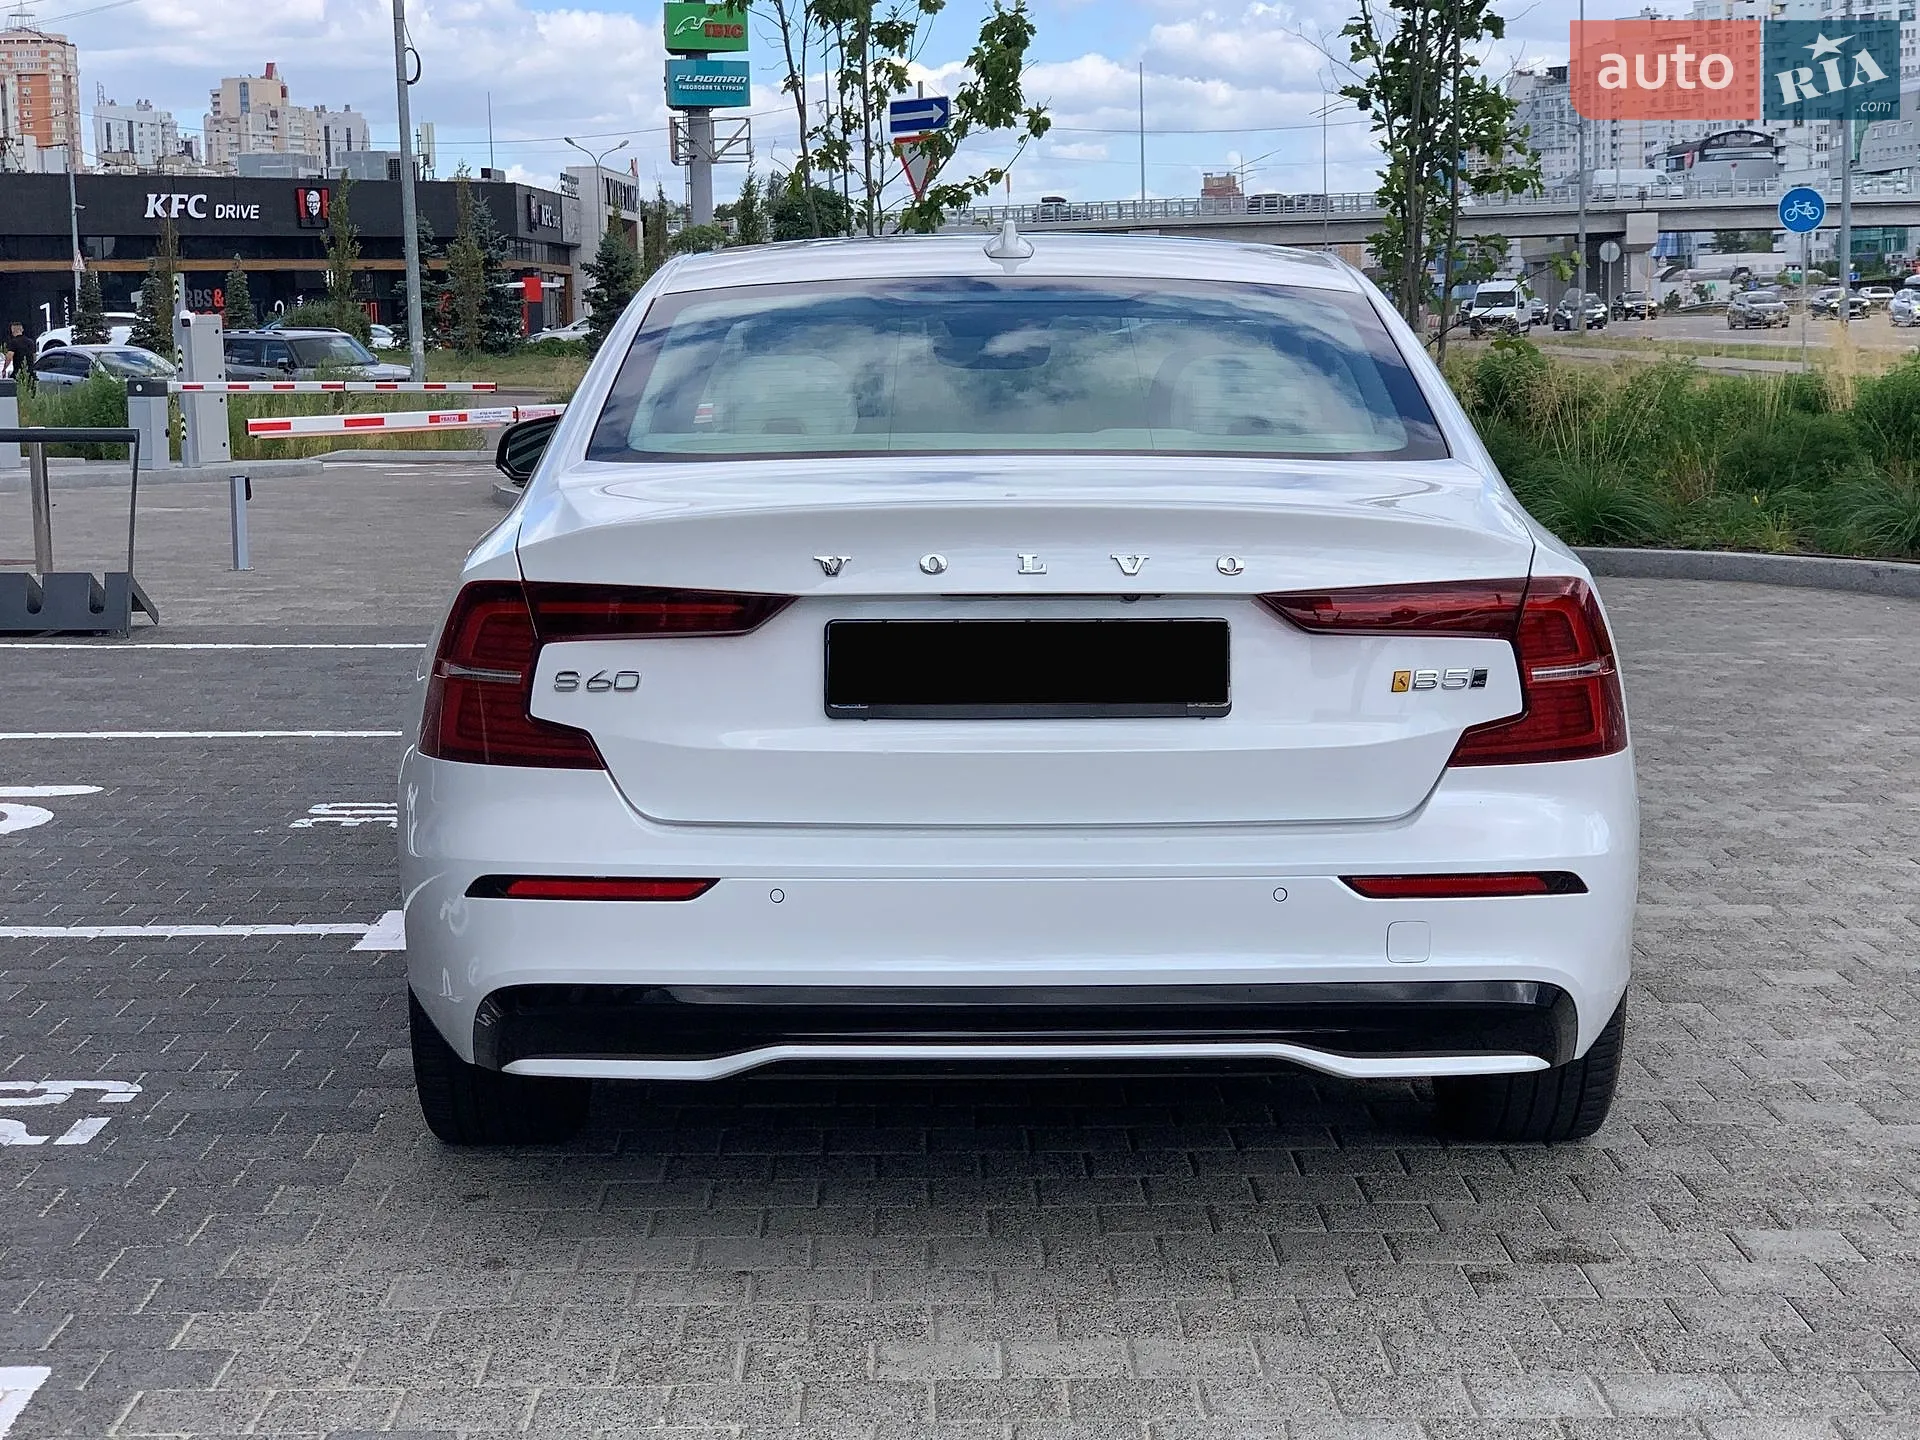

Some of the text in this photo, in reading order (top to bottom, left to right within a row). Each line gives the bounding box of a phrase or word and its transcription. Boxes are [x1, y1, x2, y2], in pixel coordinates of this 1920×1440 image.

[674, 74, 747, 84] FLAGMAN
[144, 193, 260, 219] KFC DRIVE
[813, 553, 1246, 578] VOLVO
[554, 669, 641, 692] S60
[1411, 667, 1470, 691] B5
